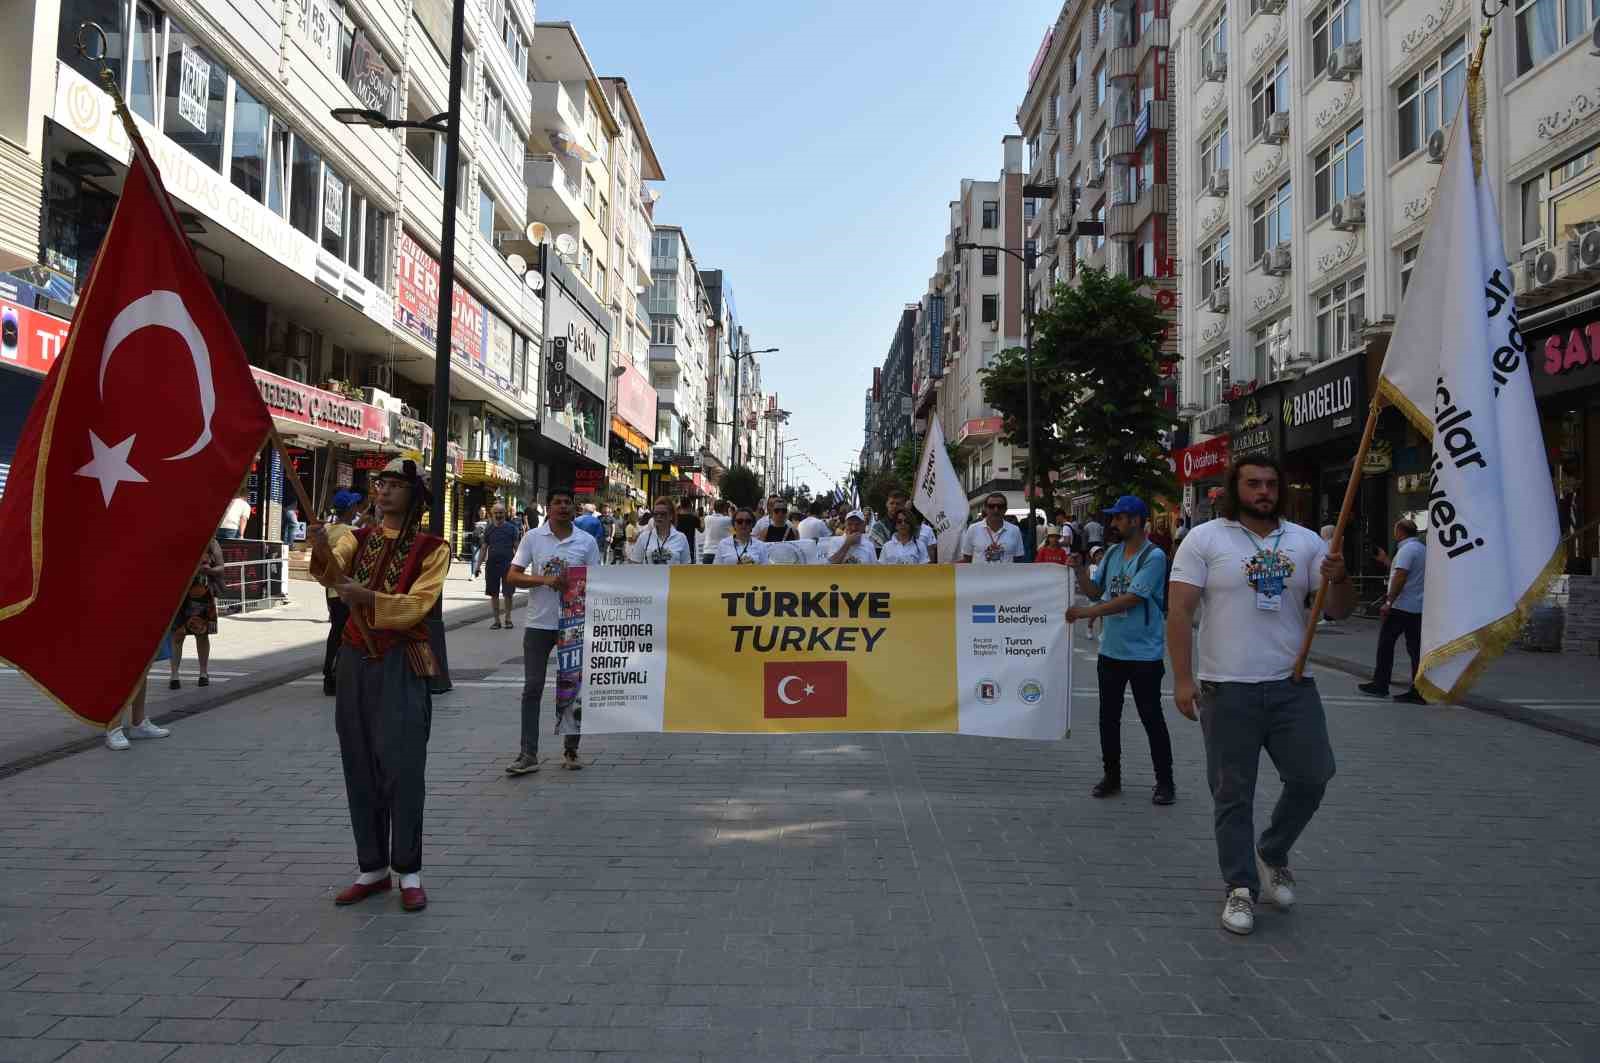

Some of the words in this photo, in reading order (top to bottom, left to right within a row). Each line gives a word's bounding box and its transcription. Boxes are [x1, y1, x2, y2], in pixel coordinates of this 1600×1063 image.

[1293, 375, 1352, 427] BARGELLO
[721, 584, 891, 618] TÜRKİYE
[998, 615, 1047, 625] Belediyesi
[592, 624, 653, 637] BATHONEA
[730, 625, 887, 653] TURKEY
[1005, 637, 1033, 645] Turan
[639, 643, 653, 653] ve
[590, 656, 629, 669] SANAT
[589, 671, 648, 685] FESTİVALİ
